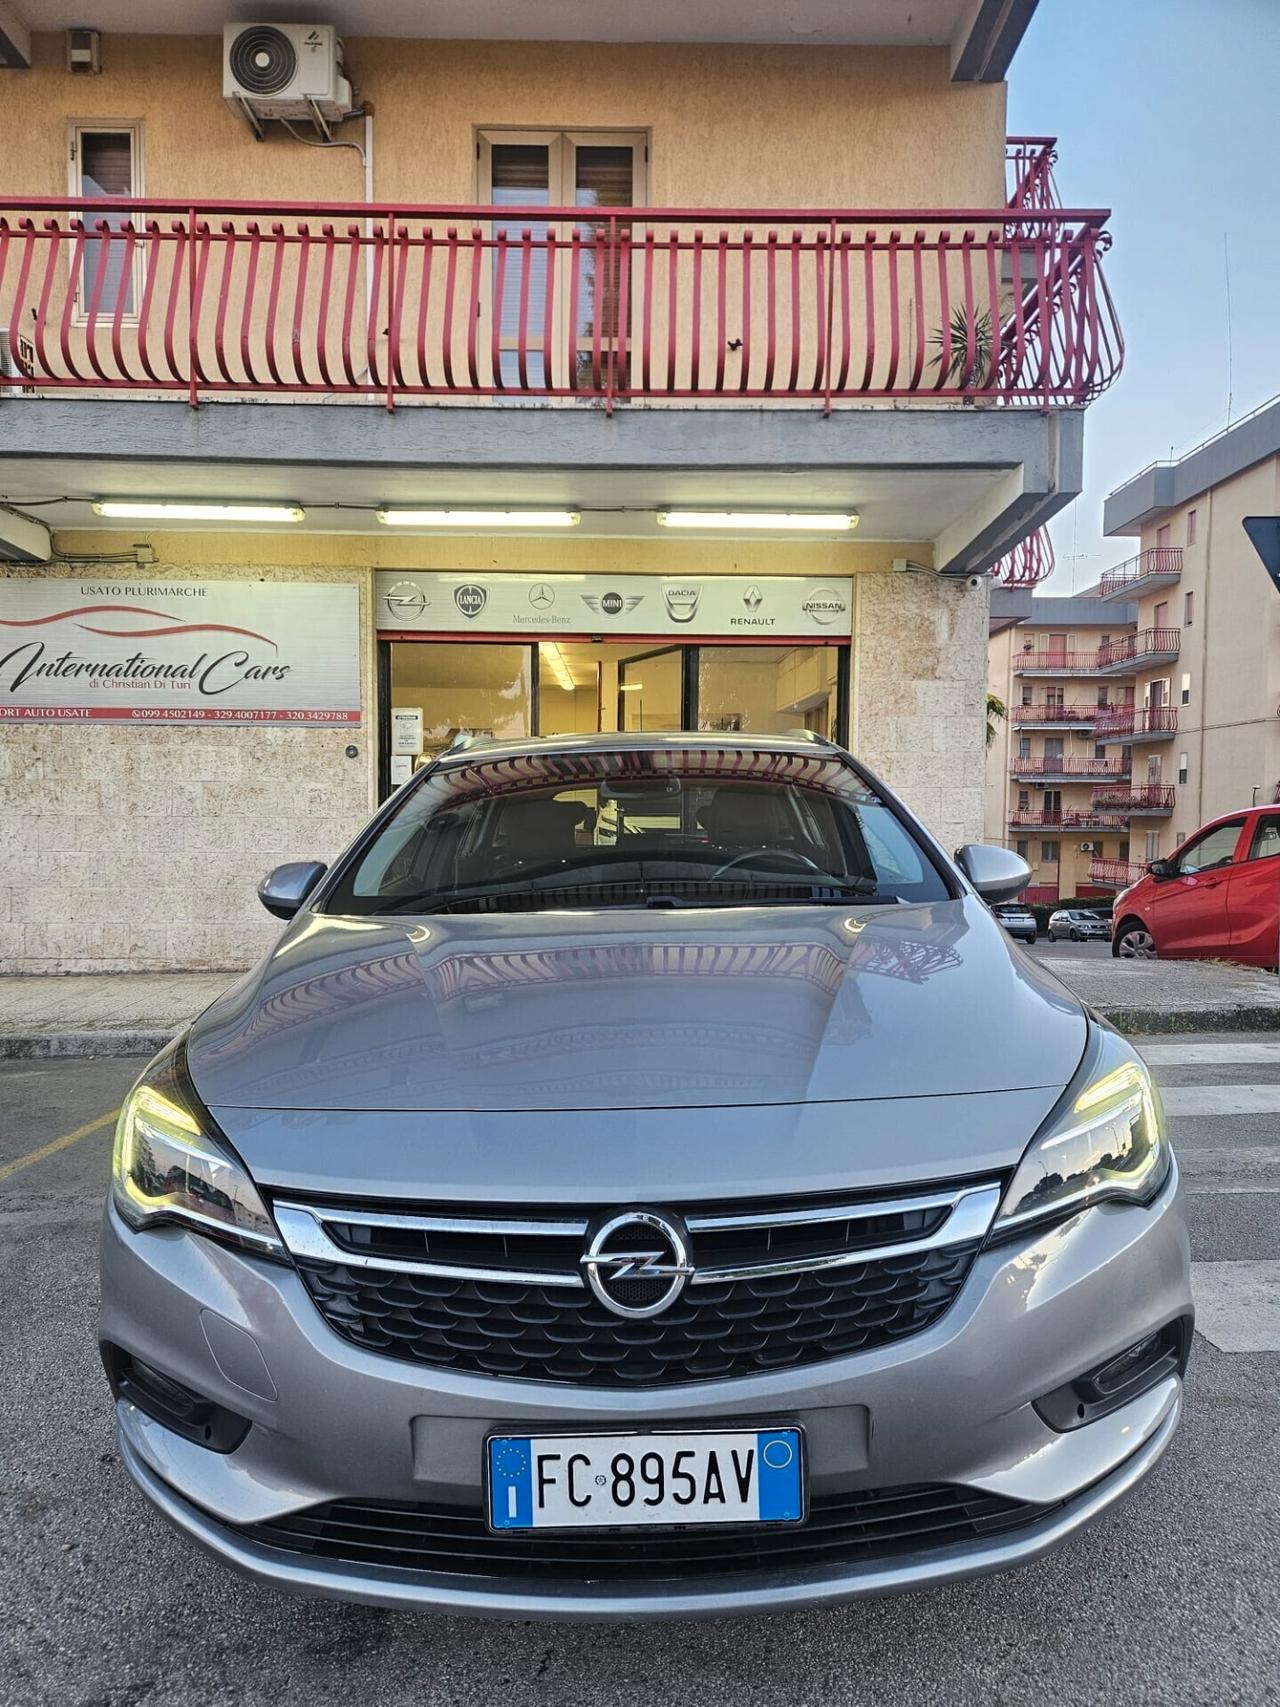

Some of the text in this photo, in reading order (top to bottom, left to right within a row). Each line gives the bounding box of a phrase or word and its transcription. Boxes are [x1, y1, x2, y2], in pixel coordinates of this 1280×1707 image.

[81, 586, 208, 597] USATO PLURIMARCHE
[667, 589, 697, 597] DACIA
[460, 595, 482, 605] LANCIA
[602, 600, 622, 608] MINI
[806, 602, 842, 610] NISSAN
[513, 614, 571, 625] Mercedes-Benz
[730, 618, 776, 626] RENAULT
[0, 641, 293, 696] International Cars
[89, 679, 192, 690] di Christian Di Turi
[24, 708, 56, 718] AUTO
[58, 709, 92, 718] USATE
[141, 710, 206, 719] 099.4502149
[214, 711, 277, 720] 329.4007177
[286, 711, 349, 721] 320.3429788
[537, 1448, 754, 1508] FC 895AV
